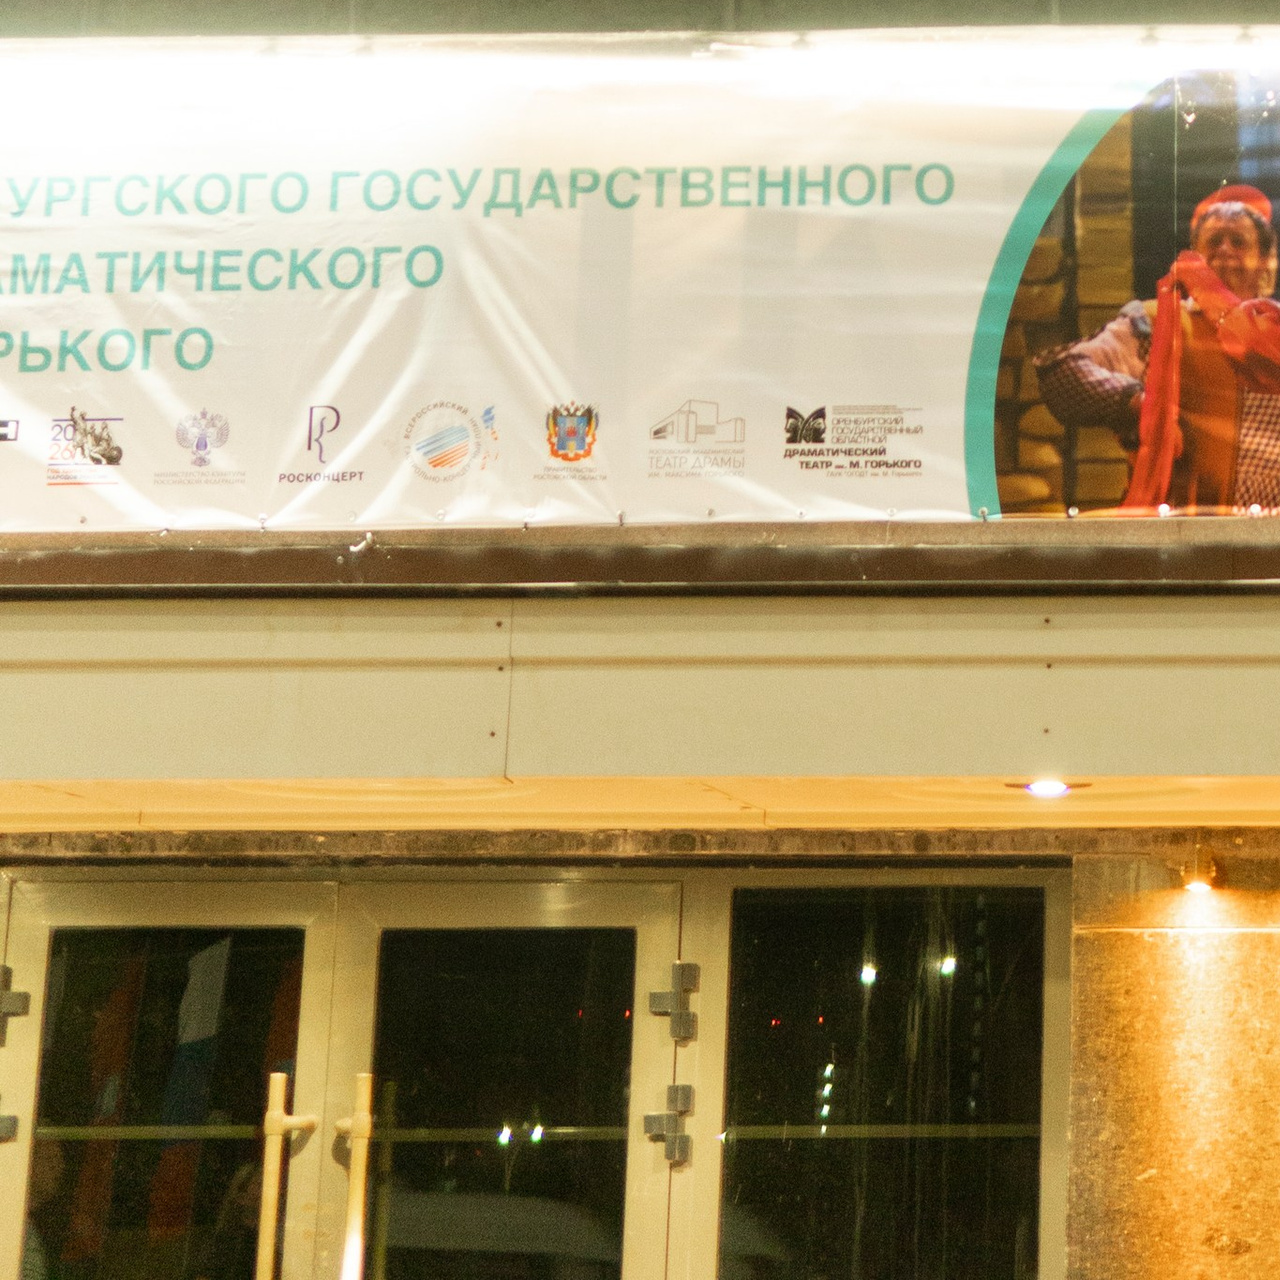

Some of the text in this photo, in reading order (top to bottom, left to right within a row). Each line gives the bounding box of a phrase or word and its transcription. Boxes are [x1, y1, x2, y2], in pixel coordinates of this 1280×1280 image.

[5, 162, 955, 217] УРГСКОГО ГОСУДАРСТВЕННОГО
[0, 245, 445, 295] МАТИЧЕСКОГО
[784, 446, 887, 458] ДРАМАТИЧЕСКИЙ
[648, 456, 745, 469] ТЕАТР ДРАМЫ
[799, 460, 833, 469] ТЕАТР
[864, 459, 922, 469] ГОРЬКОГО
[278, 471, 365, 484] РОСКОНЦЕРТ
